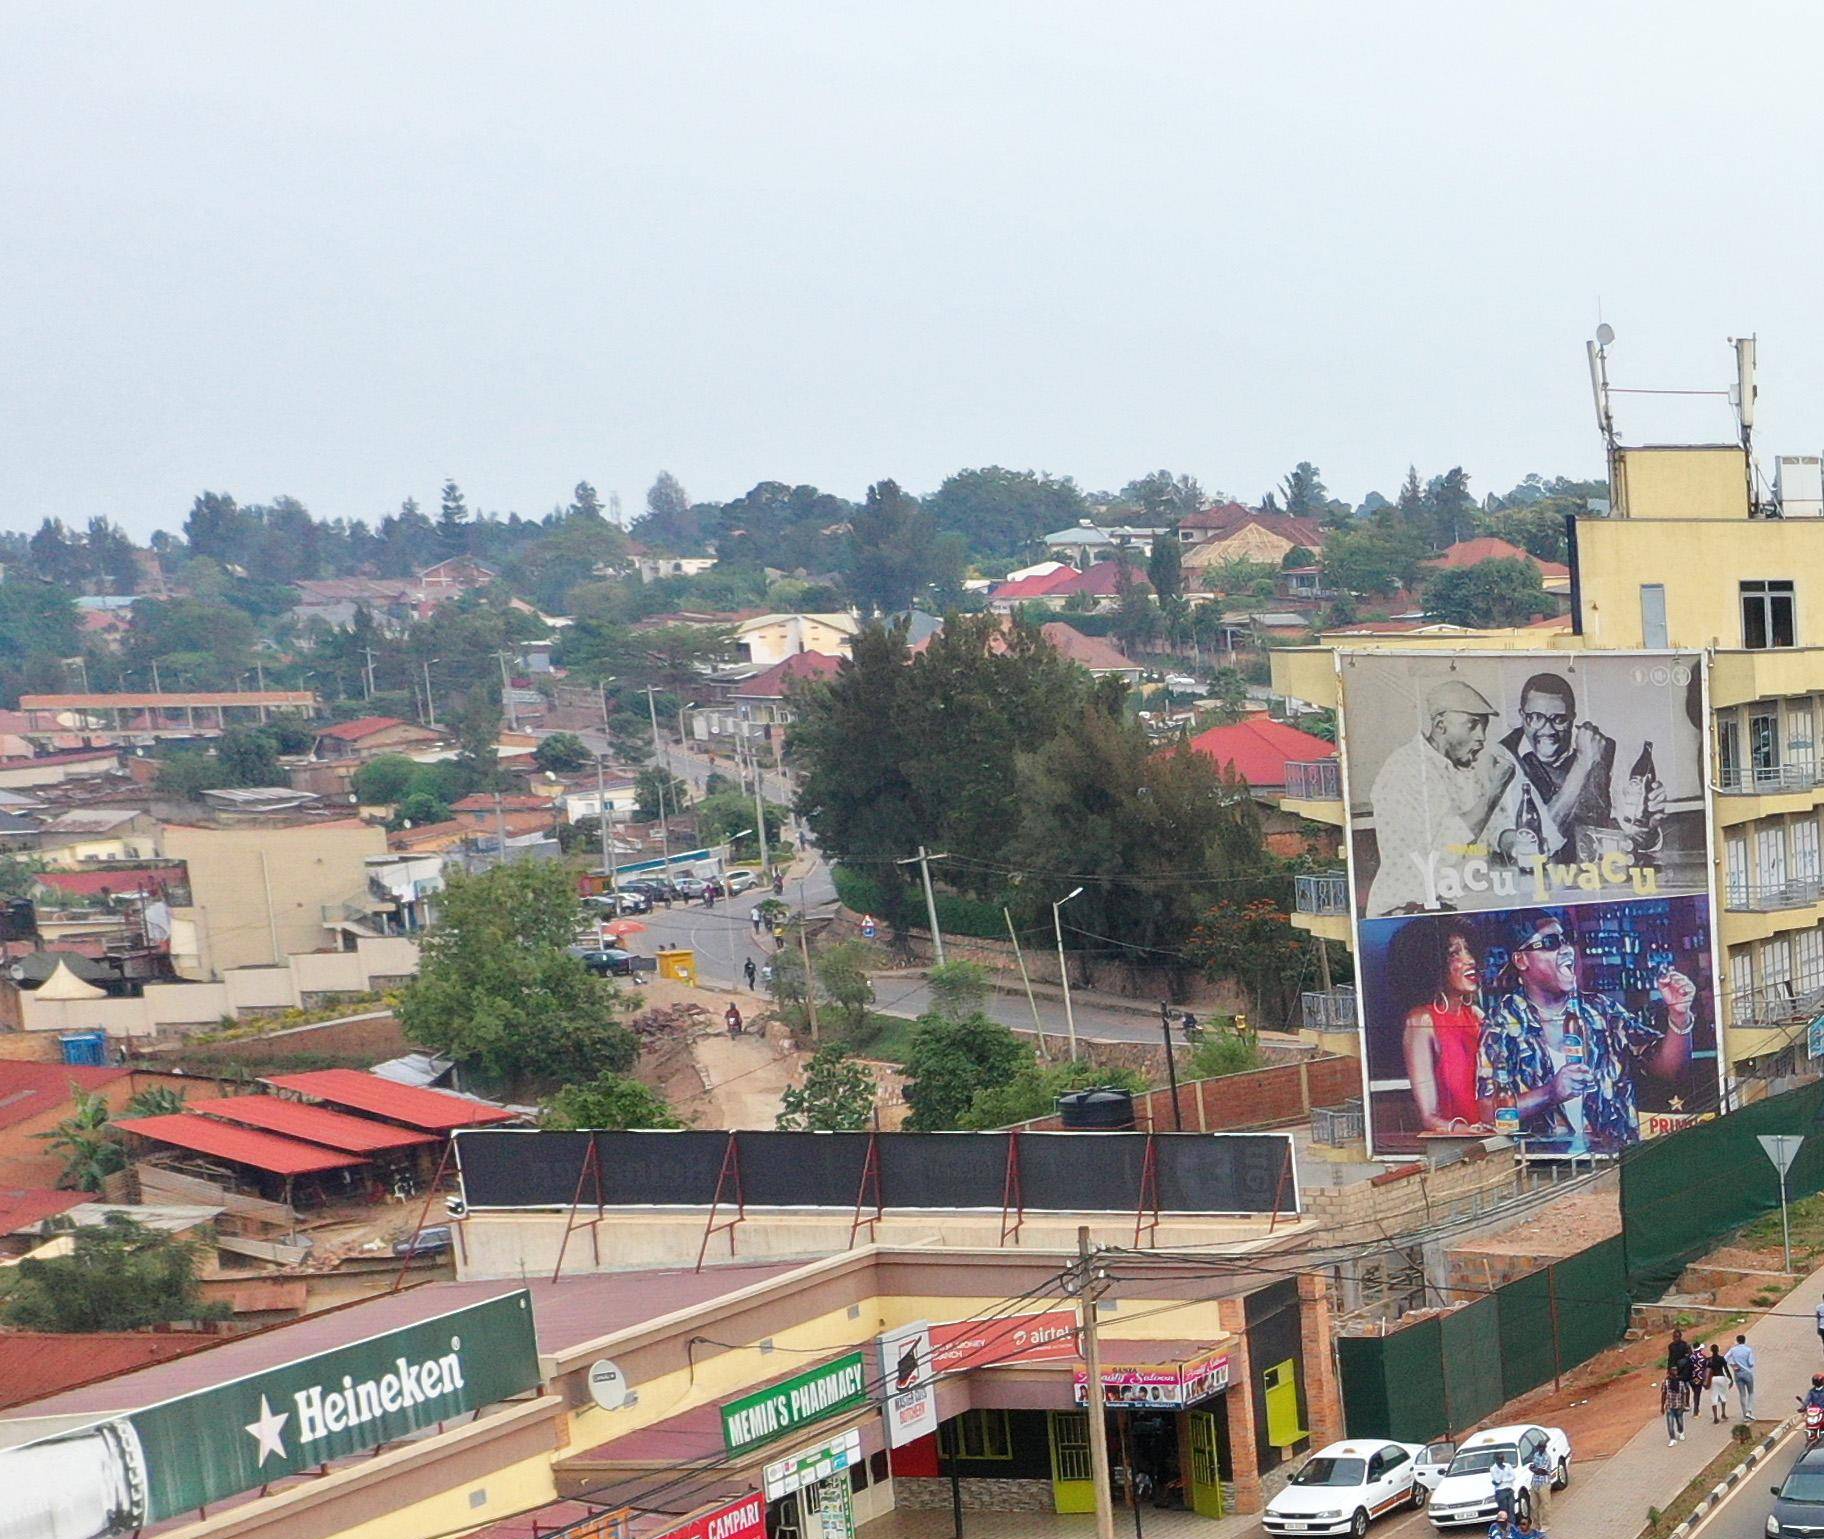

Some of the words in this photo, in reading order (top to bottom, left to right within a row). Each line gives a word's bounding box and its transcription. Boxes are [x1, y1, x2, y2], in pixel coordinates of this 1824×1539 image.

[1409, 850, 1518, 910] Yacu
[294, 1349, 465, 1445] Heineken
[728, 1395, 790, 1448] MEMIA'S
[790, 1362, 862, 1422] PHARMACY
